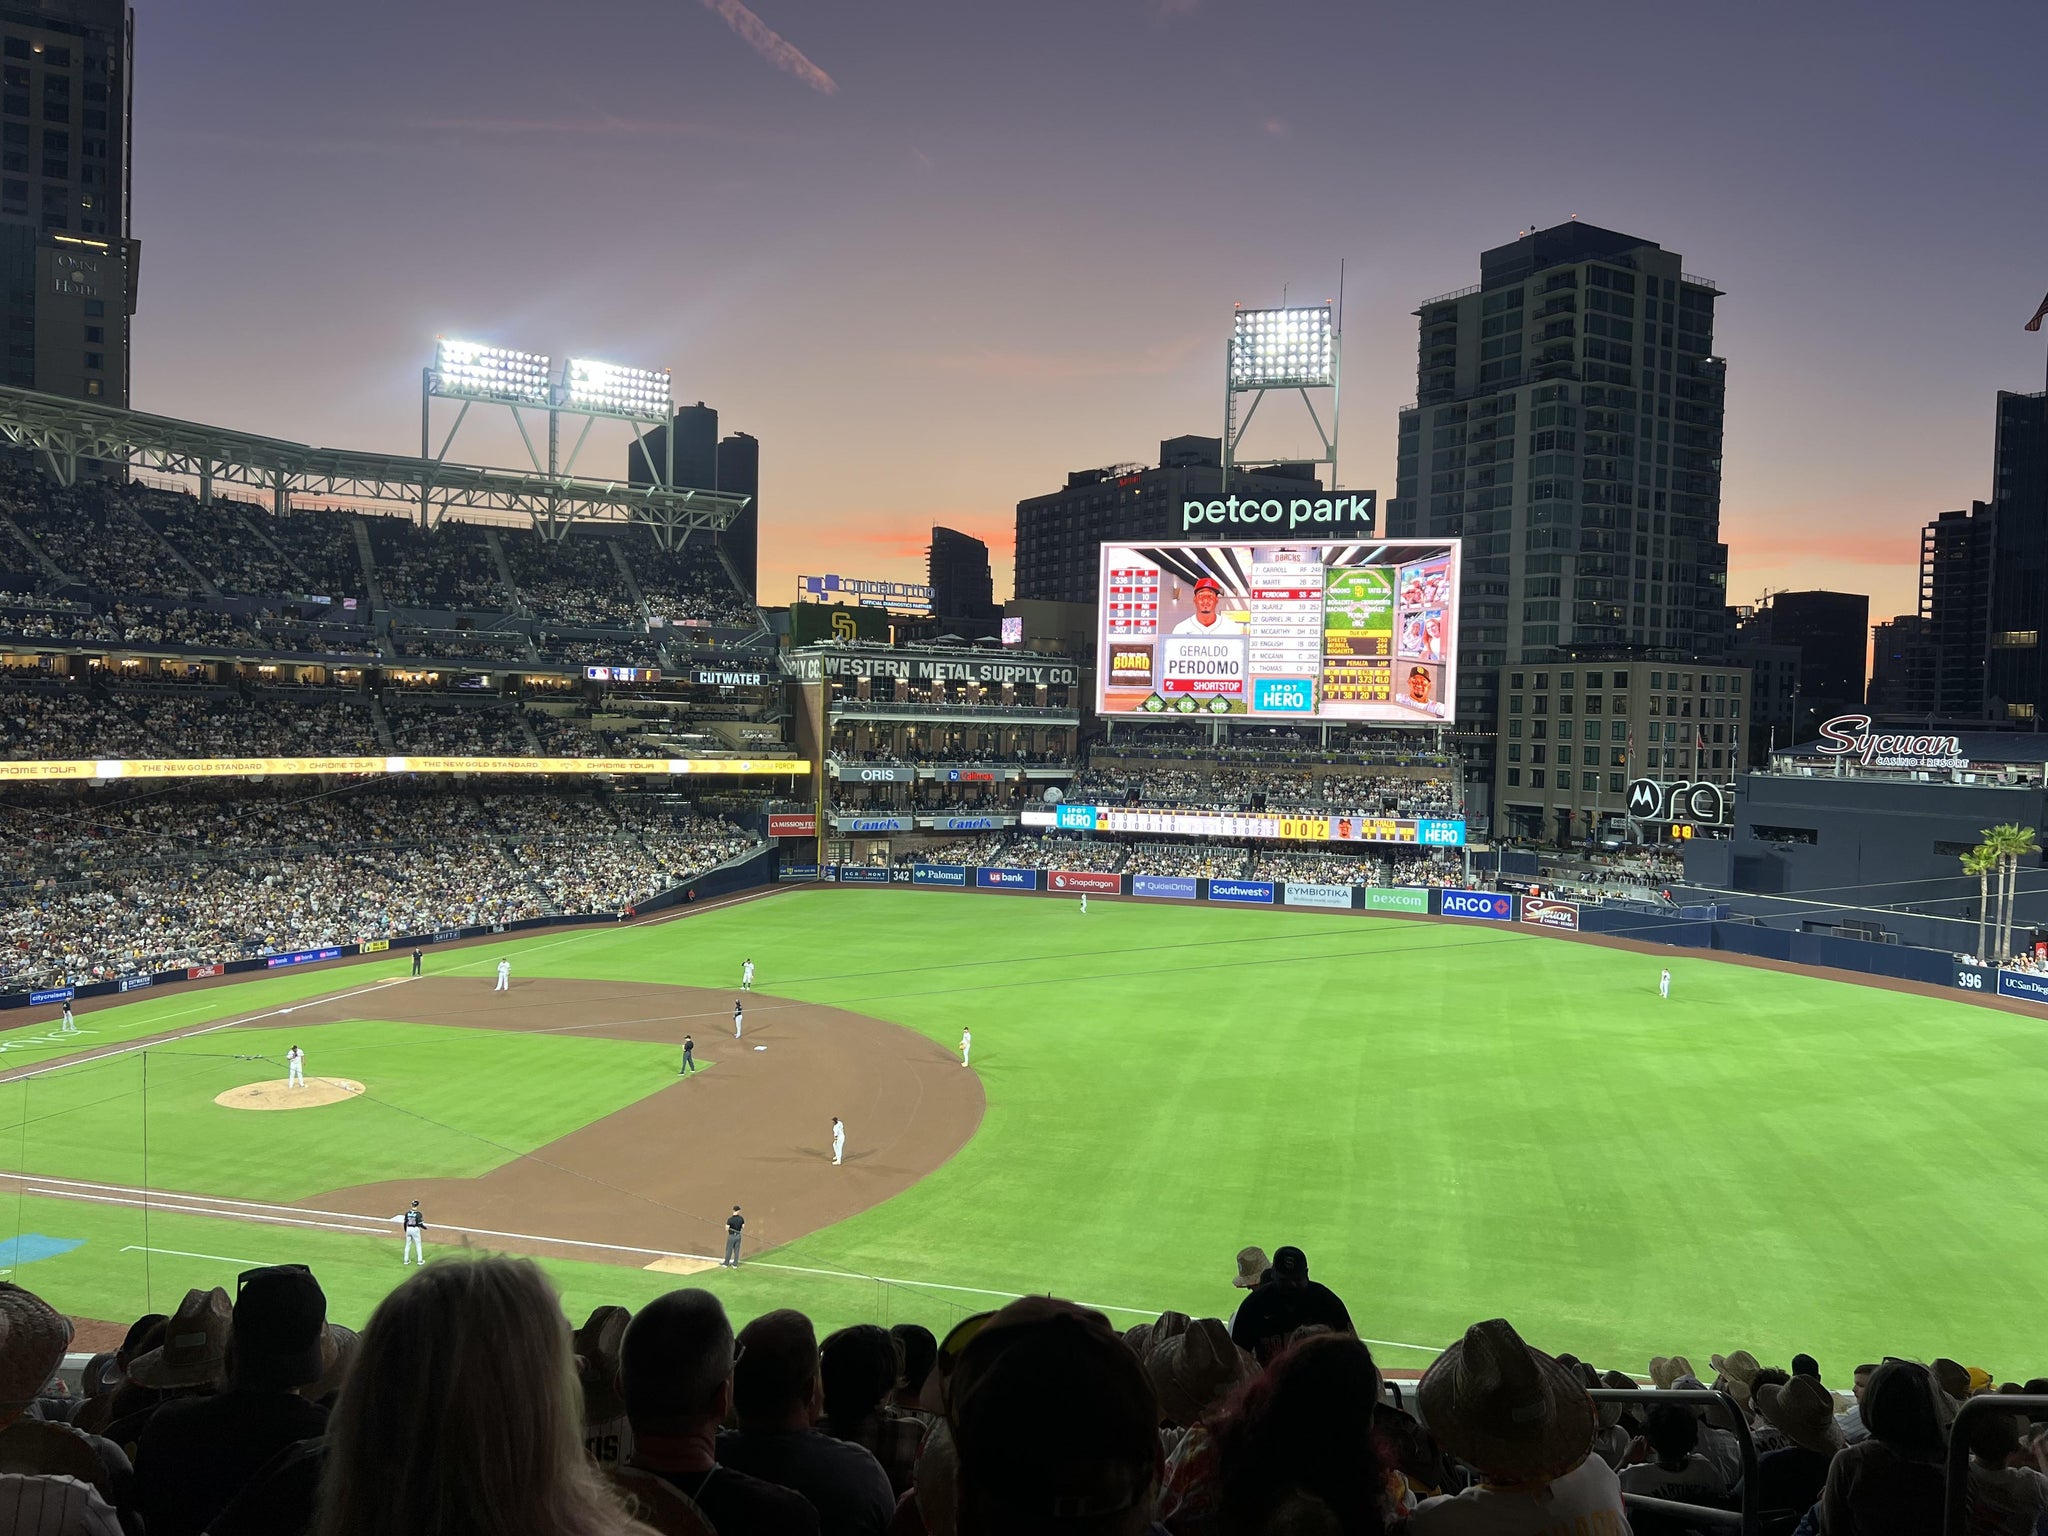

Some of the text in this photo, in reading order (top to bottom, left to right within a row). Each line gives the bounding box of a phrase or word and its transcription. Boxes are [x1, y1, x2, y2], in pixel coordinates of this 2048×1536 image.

[1183, 495, 1371, 531] petco park
[844, 579, 936, 599] QuidelOrtho
[1180, 646, 1228, 657] GERALDO
[1114, 656, 1149, 669] BOARD
[1169, 661, 1239, 674] PERDOMO
[824, 657, 1076, 684] WESTERN METAL SUPPLY CO.
[700, 672, 760, 685] CUTWATER
[1166, 681, 1240, 690] #2 SHORTSTOP
[1263, 692, 1304, 707] HERO
[1148, 701, 1160, 709] P5
[1180, 701, 1192, 709] F8
[1211, 702, 1226, 711] HR
[1816, 714, 1962, 765] Sycuan
[187, 763, 213, 771] GOLD
[1875, 757, 1970, 768] CASINO RESORT
[861, 770, 894, 780] ORIS
[852, 818, 899, 831] Canel's
[948, 817, 991, 829] Canel's
[1062, 814, 1091, 827] HERO
[1374, 820, 1396, 828] PERALTA
[829, 829, 846, 839] 330
[1284, 823, 1324, 836] 0 0 2
[1425, 829, 1458, 843] HERO
[893, 871, 909, 881] 342
[927, 870, 963, 880] Palomar
[990, 873, 1023, 882] us bank
[1069, 878, 1114, 888] Snapdragon
[1147, 882, 1193, 891] QuidelOrtho
[1213, 885, 1263, 897] Southwest
[1287, 887, 1349, 898] CYMBIOTIKA
[1444, 896, 1492, 913] ARCO
[1525, 900, 1573, 923] Sycuan
[1958, 972, 1982, 989] 396
[2006, 978, 2017, 988] UC
[2018, 980, 2031, 991] San
